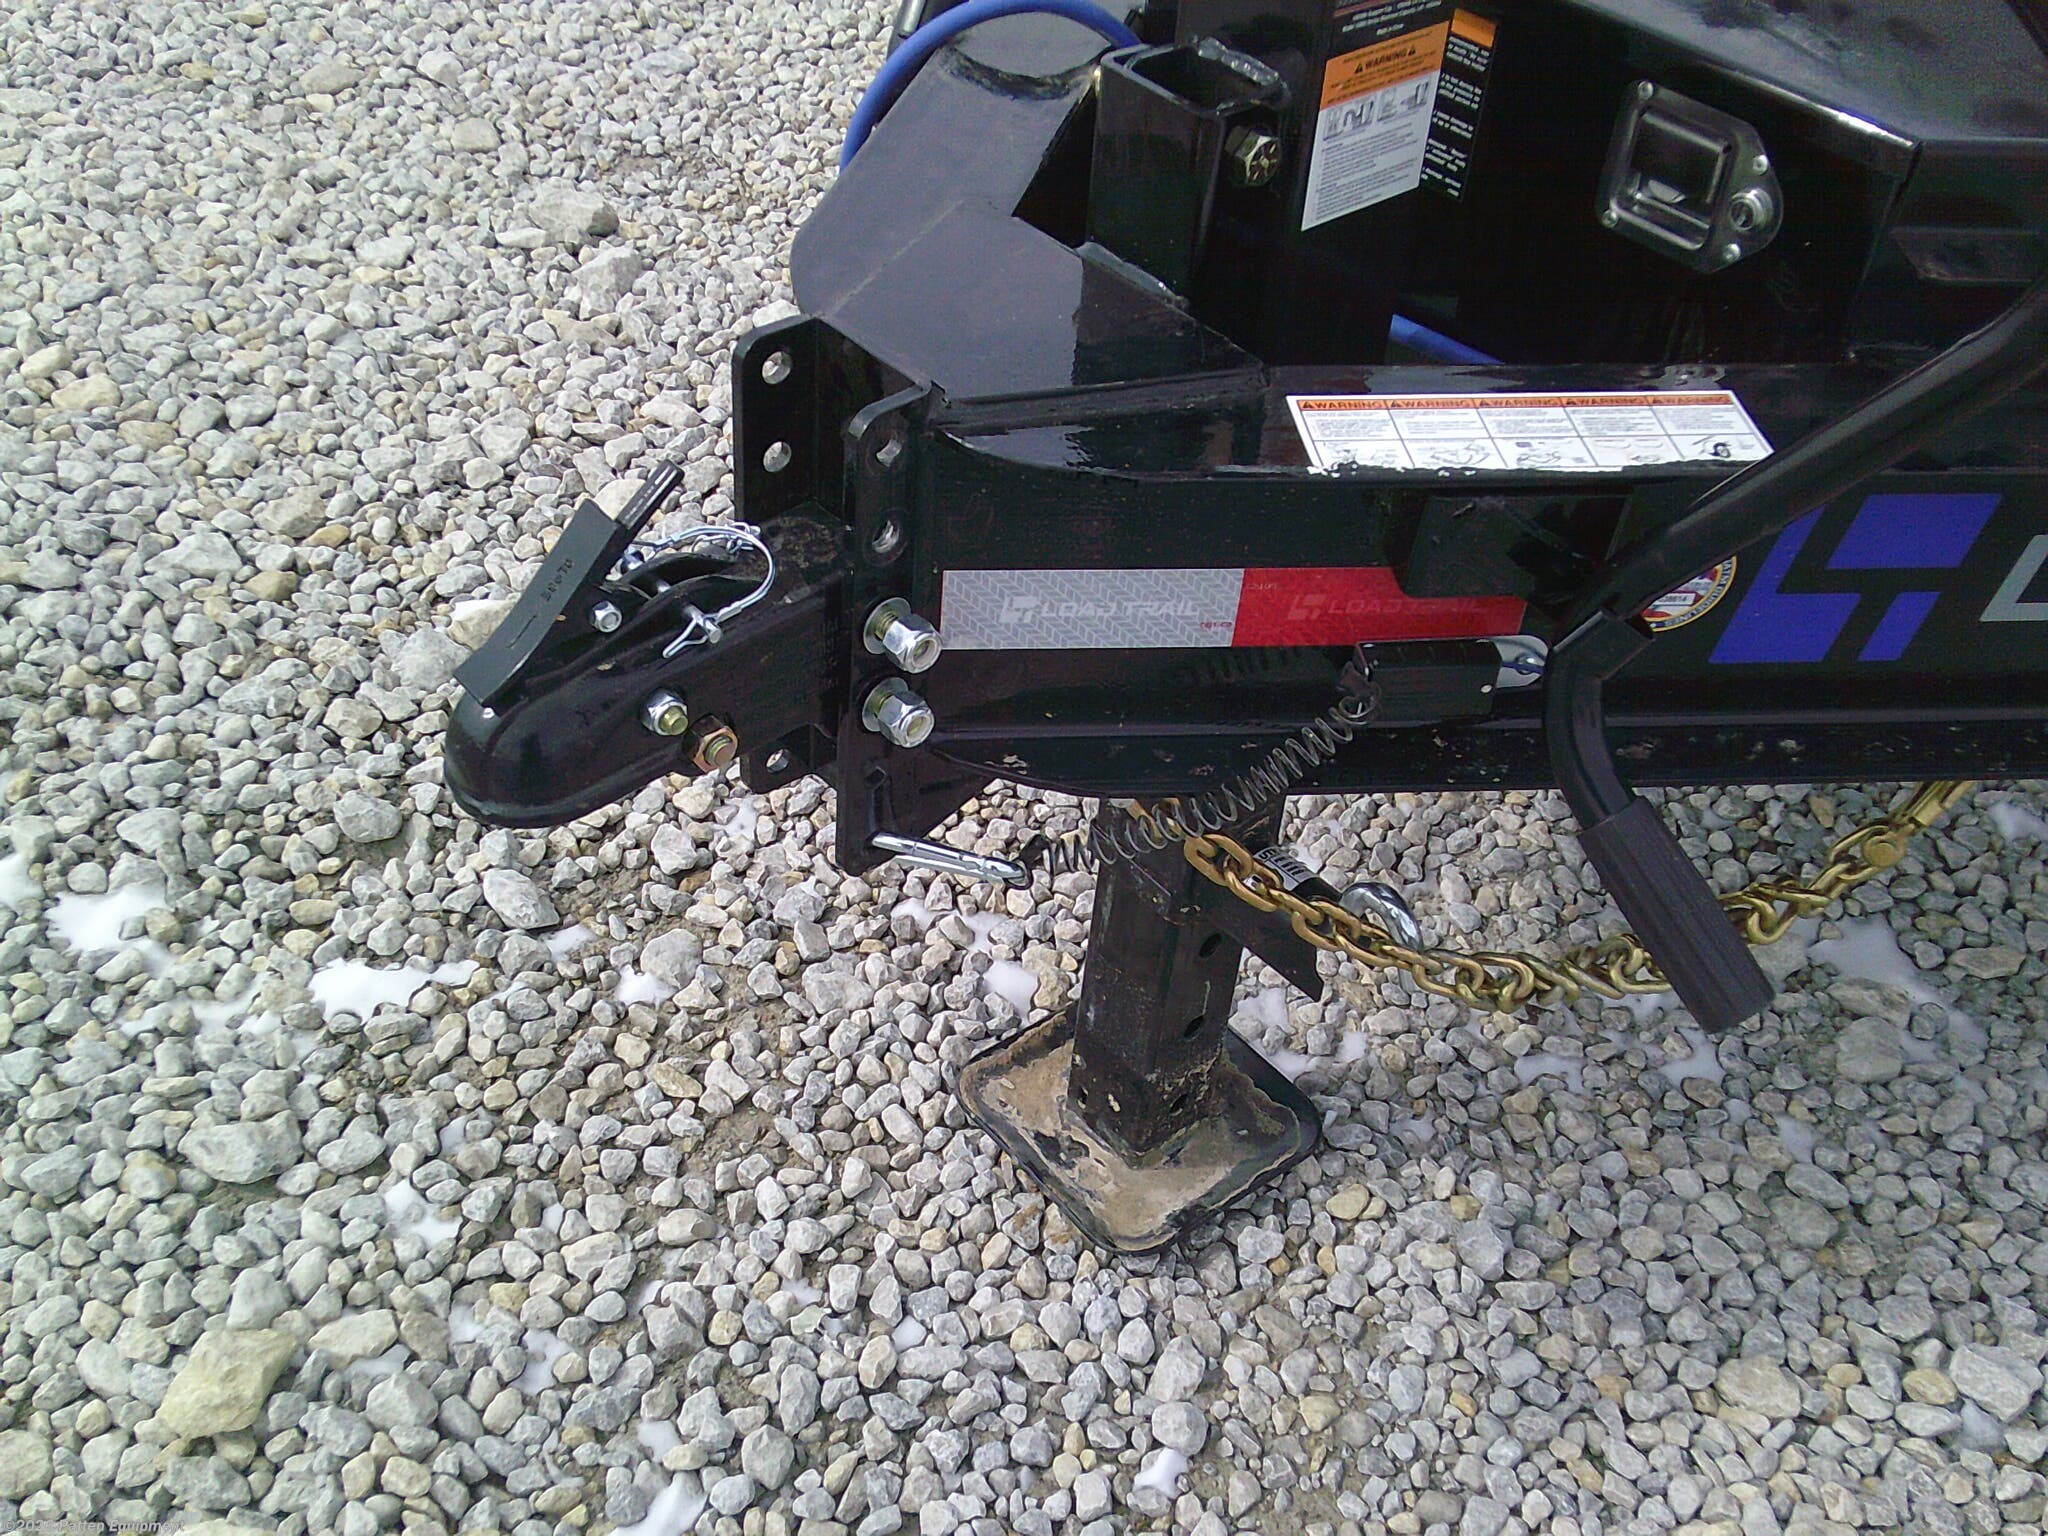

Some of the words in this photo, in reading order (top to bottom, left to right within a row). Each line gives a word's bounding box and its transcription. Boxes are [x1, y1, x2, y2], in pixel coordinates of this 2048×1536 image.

[1364, 48, 1407, 69] WARNING
[1488, 399, 1560, 407] WARNING
[1578, 397, 1642, 405] WARNING
[1665, 395, 1730, 404] WARNING
[1315, 401, 1383, 409] WARNING
[1402, 400, 1471, 408] WARNING
